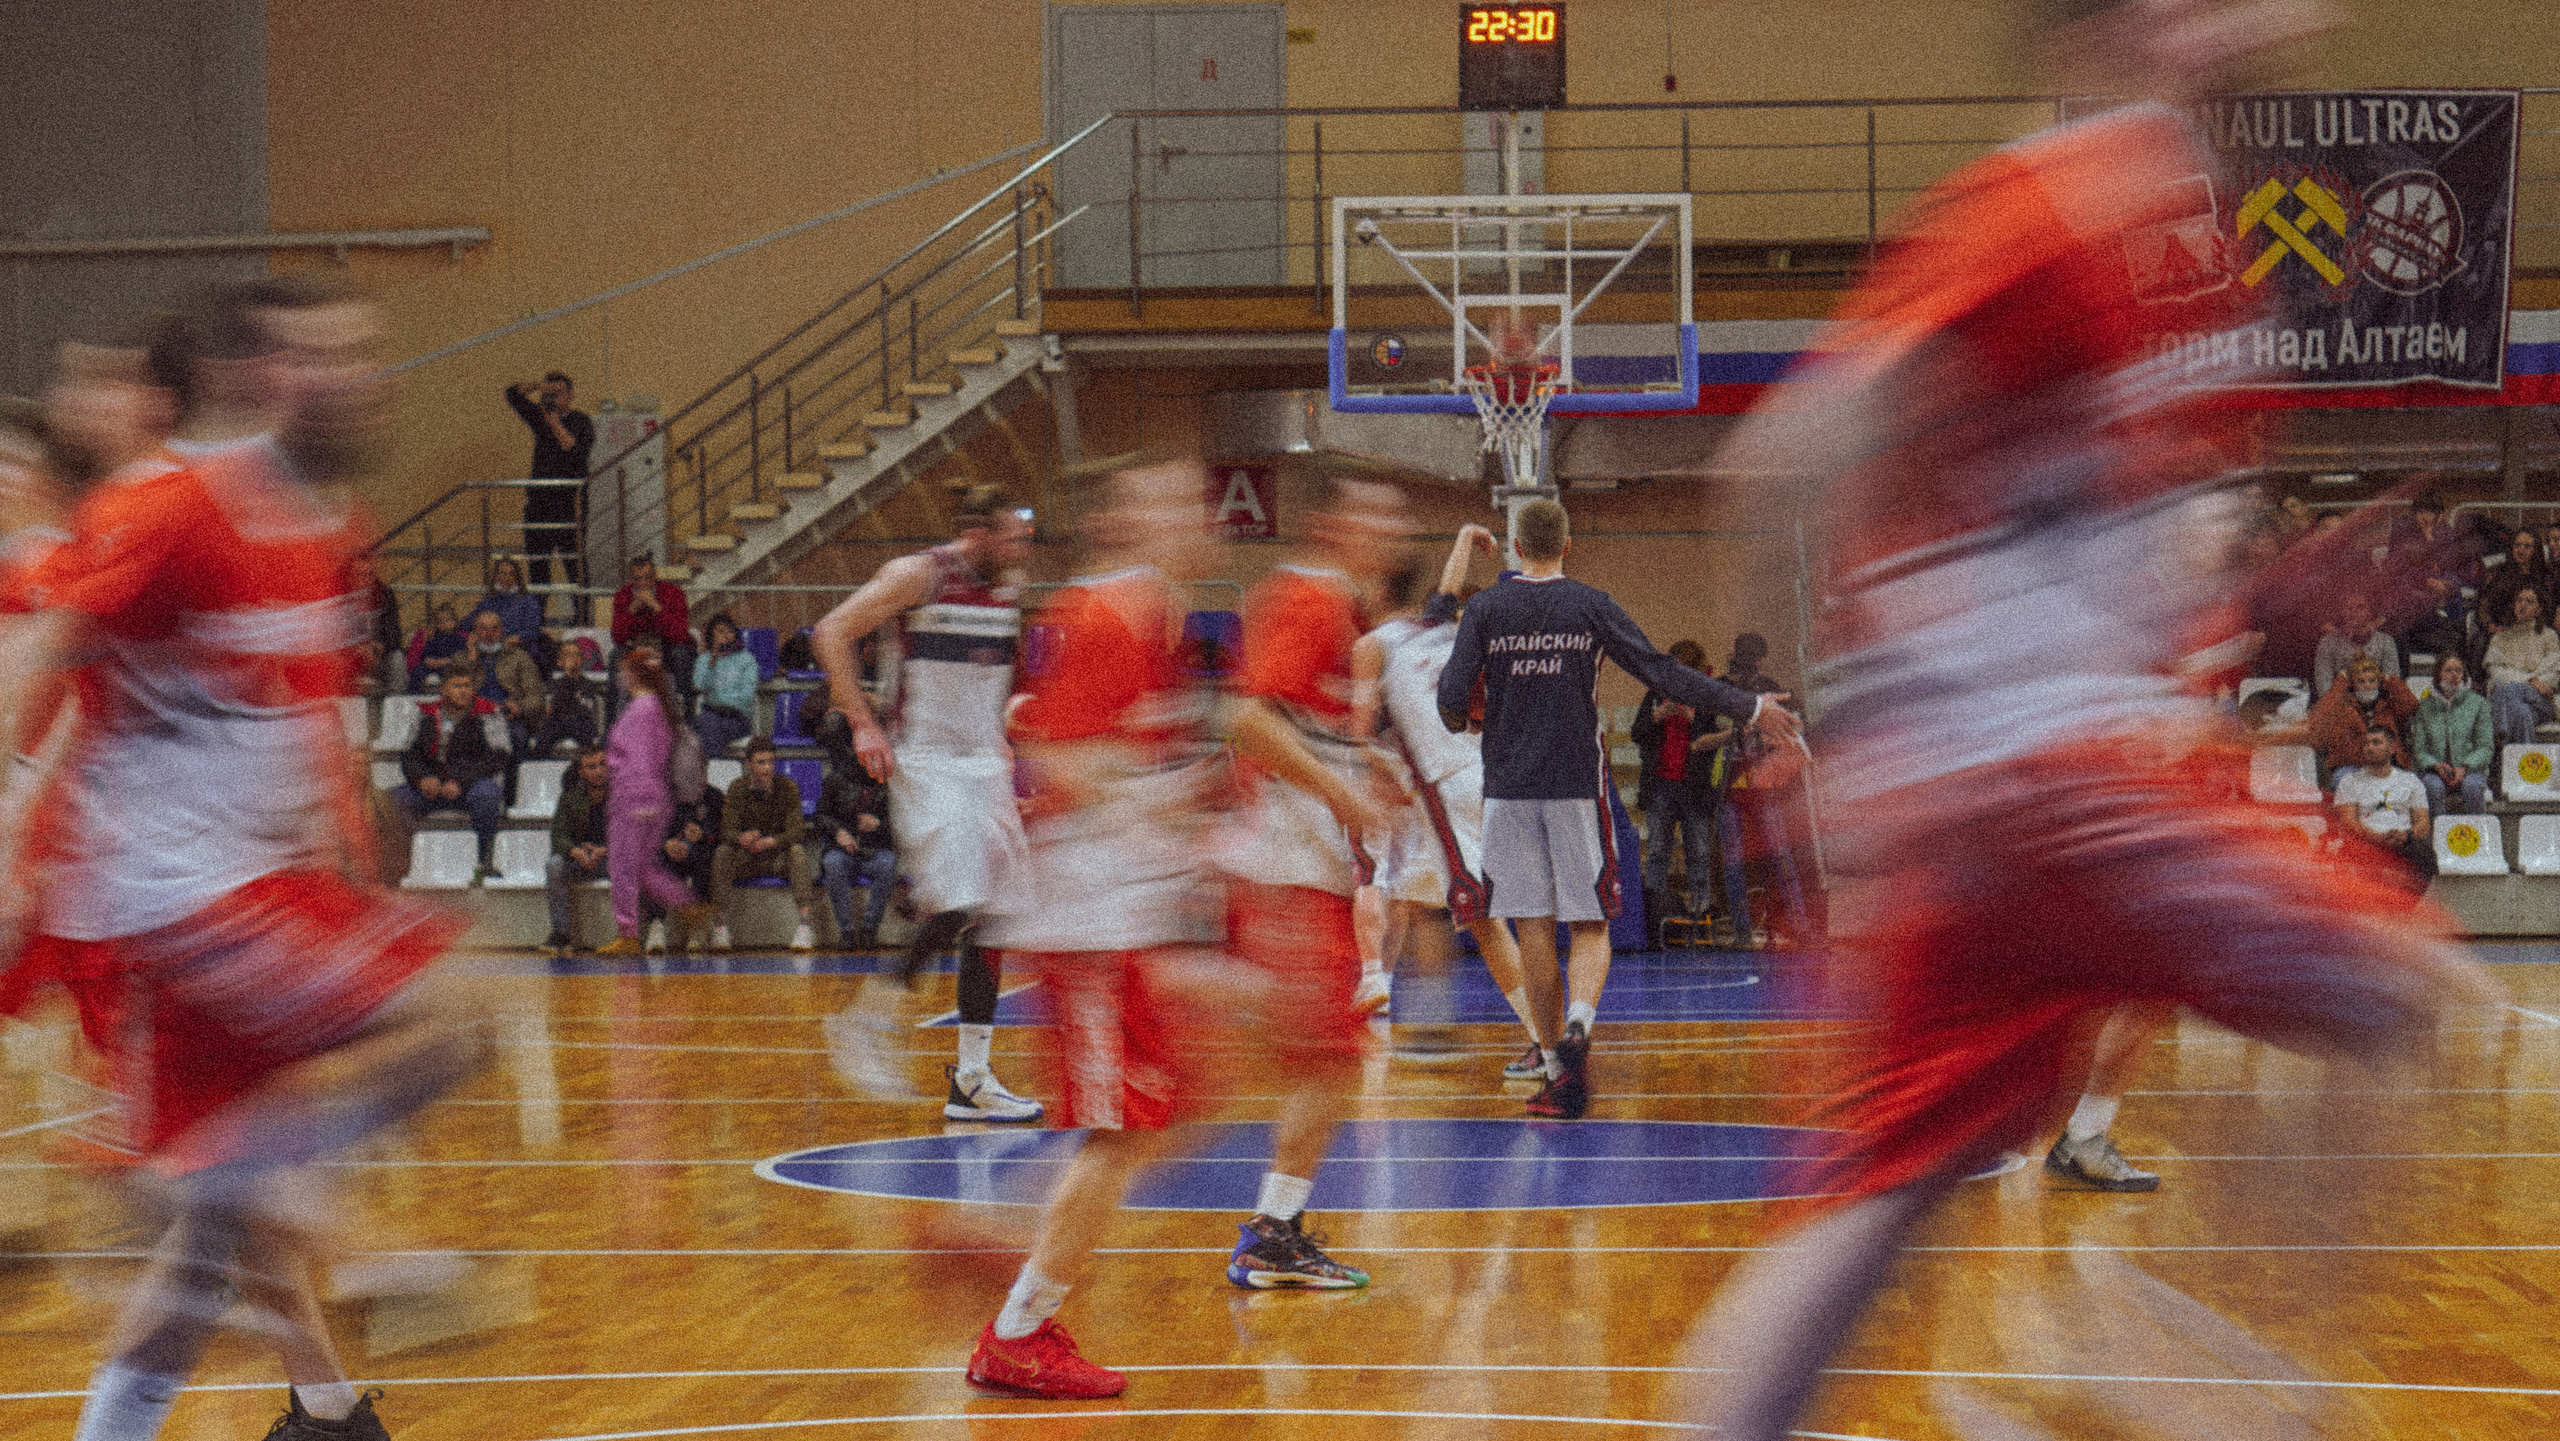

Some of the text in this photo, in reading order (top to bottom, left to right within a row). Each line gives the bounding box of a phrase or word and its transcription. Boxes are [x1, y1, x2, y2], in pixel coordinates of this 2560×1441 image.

[1469, 11, 1556, 42] 22:30
[2200, 98, 2460, 148] NAUL ULTRAS
[2136, 317, 2467, 377] торм над Алтаем
[1511, 653, 1562, 676] КРАЙ
